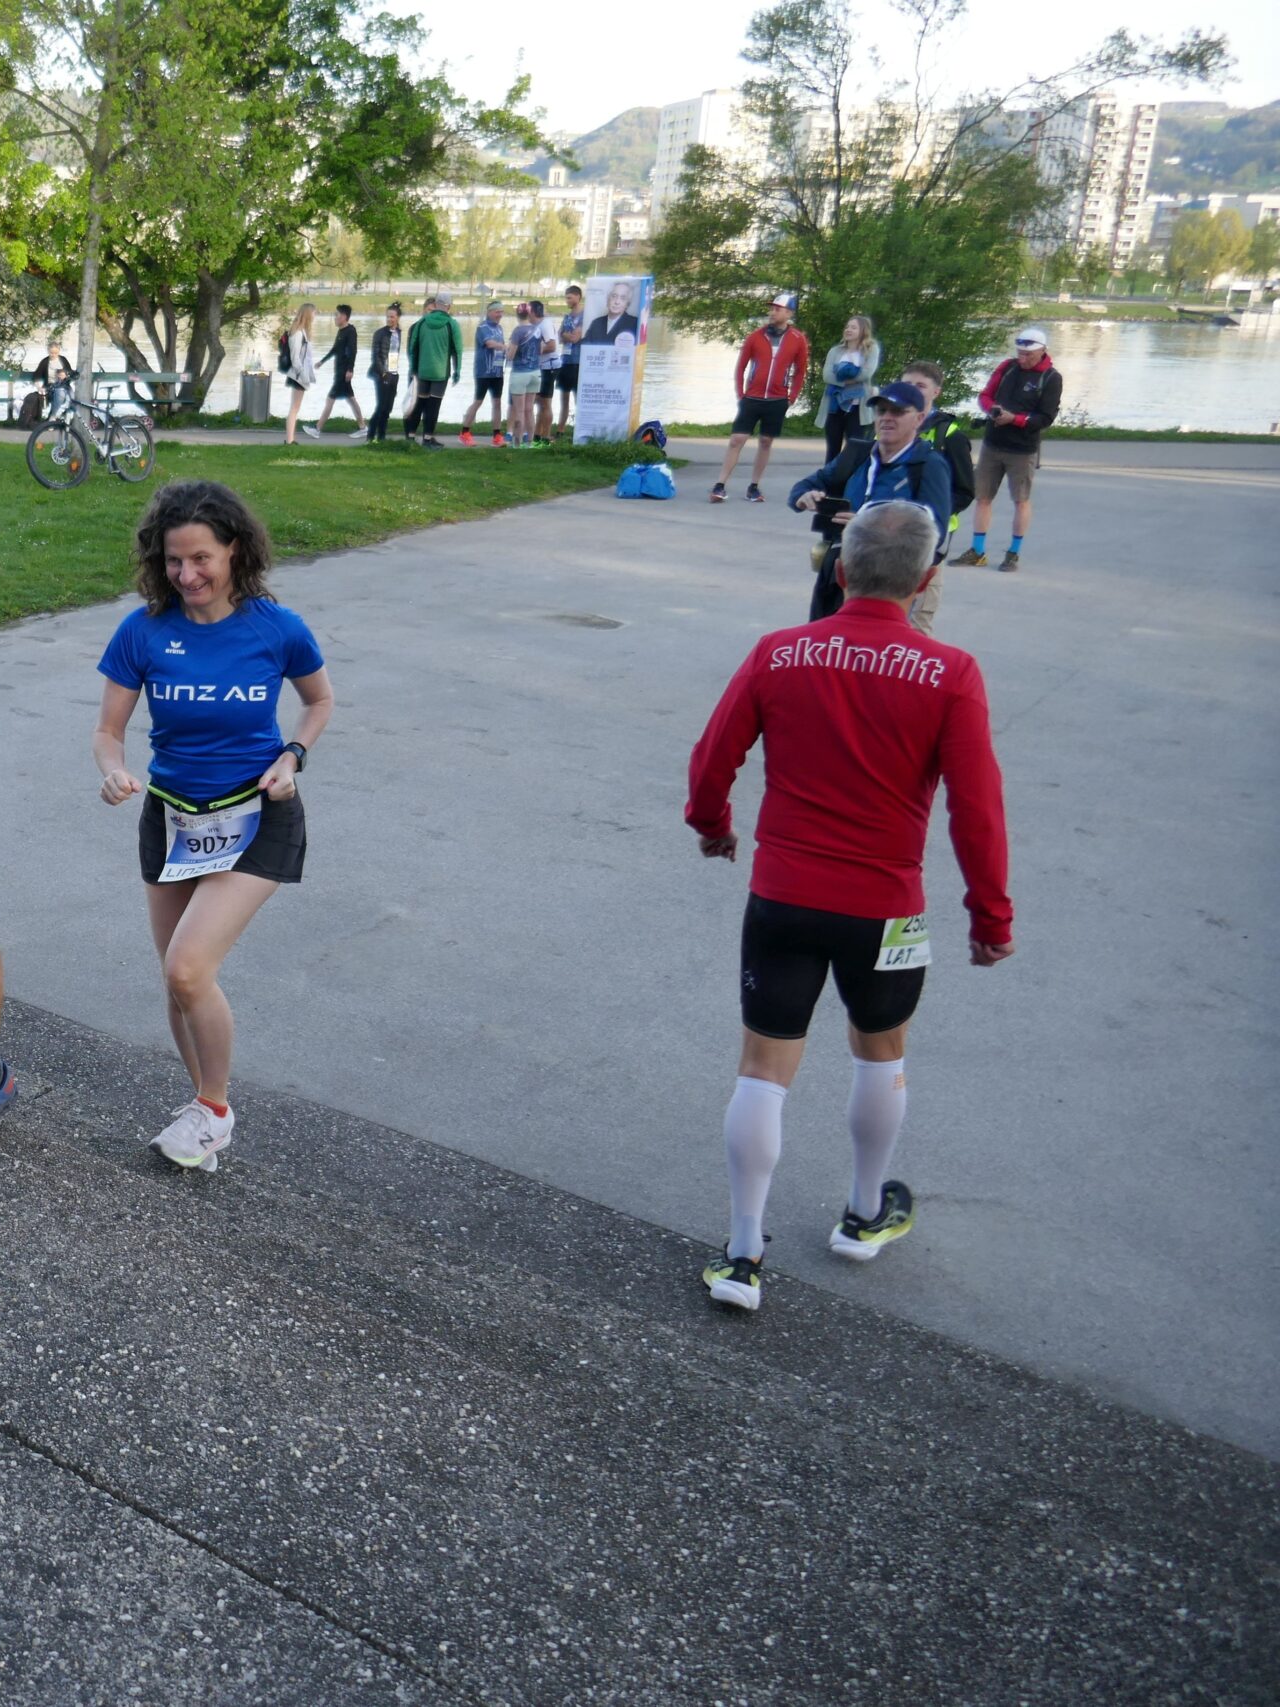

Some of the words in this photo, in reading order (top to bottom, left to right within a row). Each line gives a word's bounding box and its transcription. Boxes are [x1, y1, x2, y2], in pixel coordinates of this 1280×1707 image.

[165, 647, 186, 655] erima
[769, 636, 946, 688] skinfit
[152, 683, 216, 701] LINZ
[223, 685, 268, 702] AG
[186, 834, 242, 854] 9077
[208, 860, 234, 870] AG
